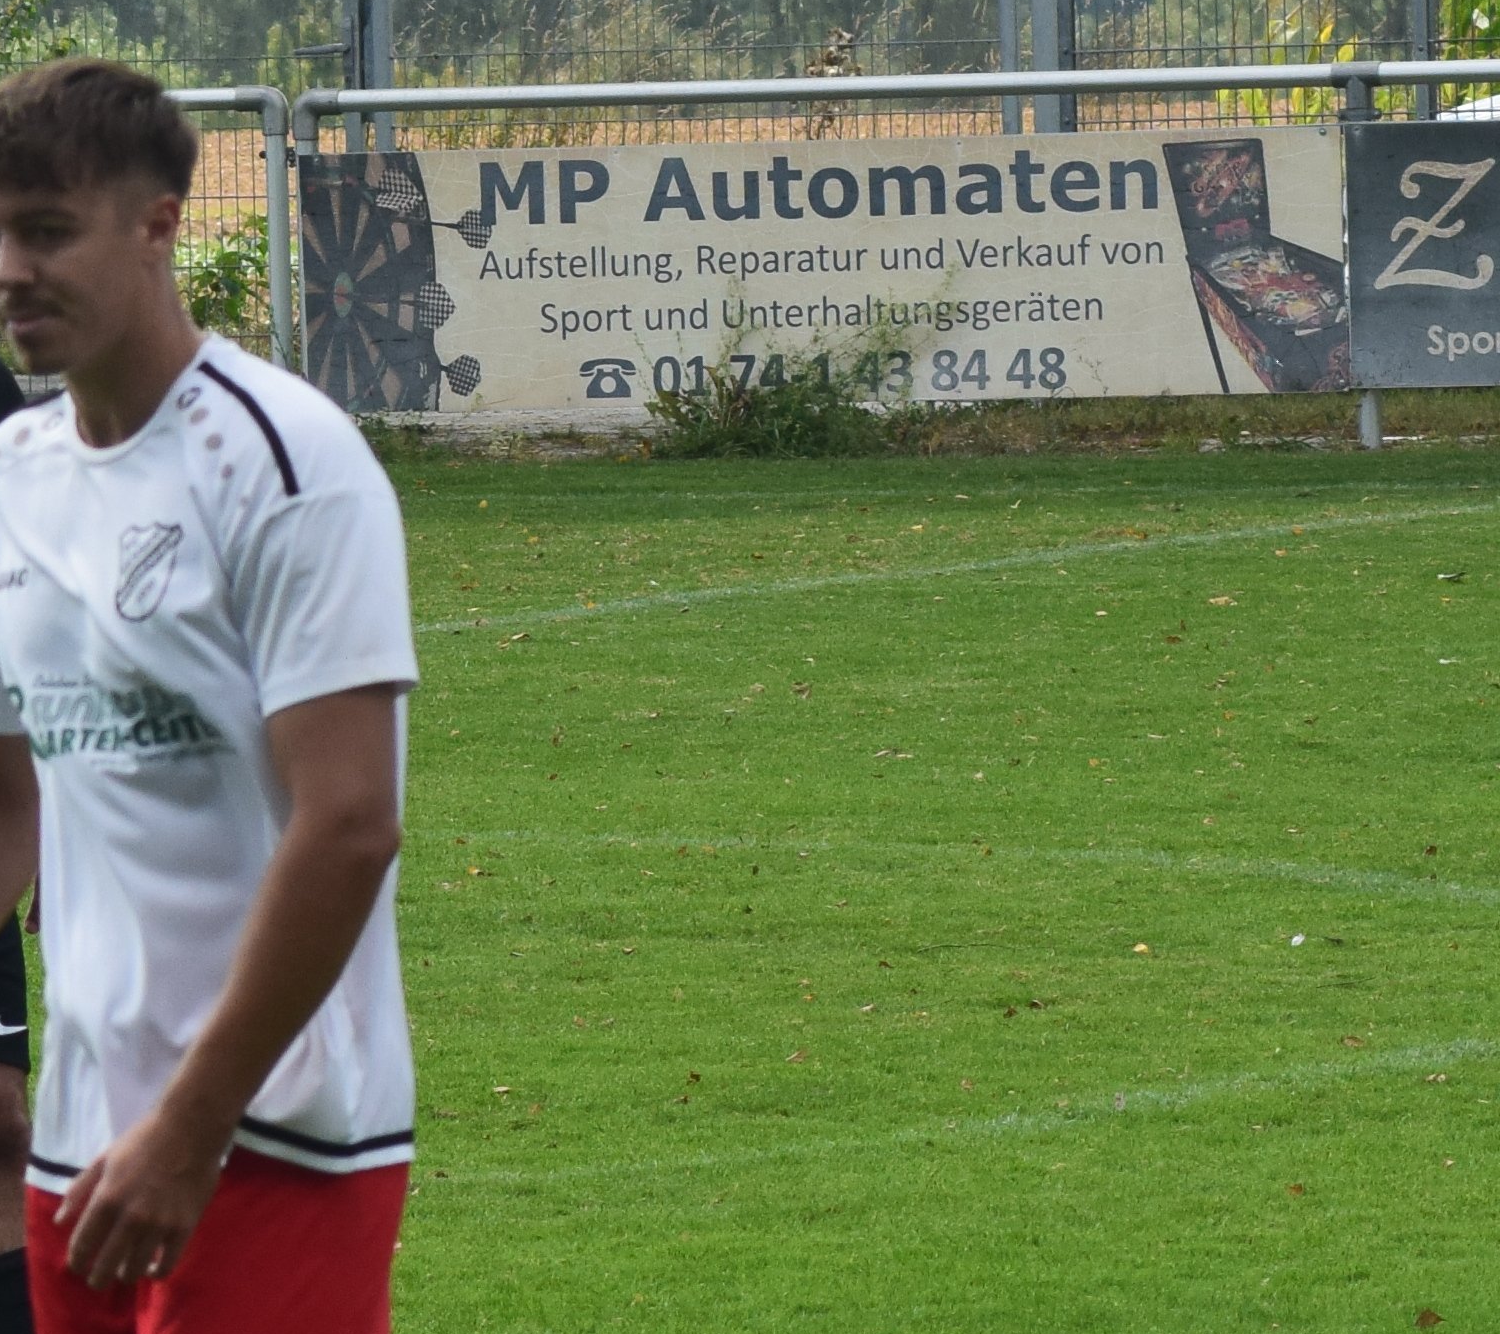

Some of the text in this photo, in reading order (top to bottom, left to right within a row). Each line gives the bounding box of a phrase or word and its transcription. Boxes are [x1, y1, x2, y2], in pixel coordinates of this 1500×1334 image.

[480, 148, 1159, 226] MP Automaten
[479, 234, 1165, 284] Aufstellung, Reparatur und Verkauf von
[540, 292, 1104, 340] Sport und Unterhaltungsgeräten
[931, 349, 990, 391] 84
[1006, 347, 1067, 390] 48
